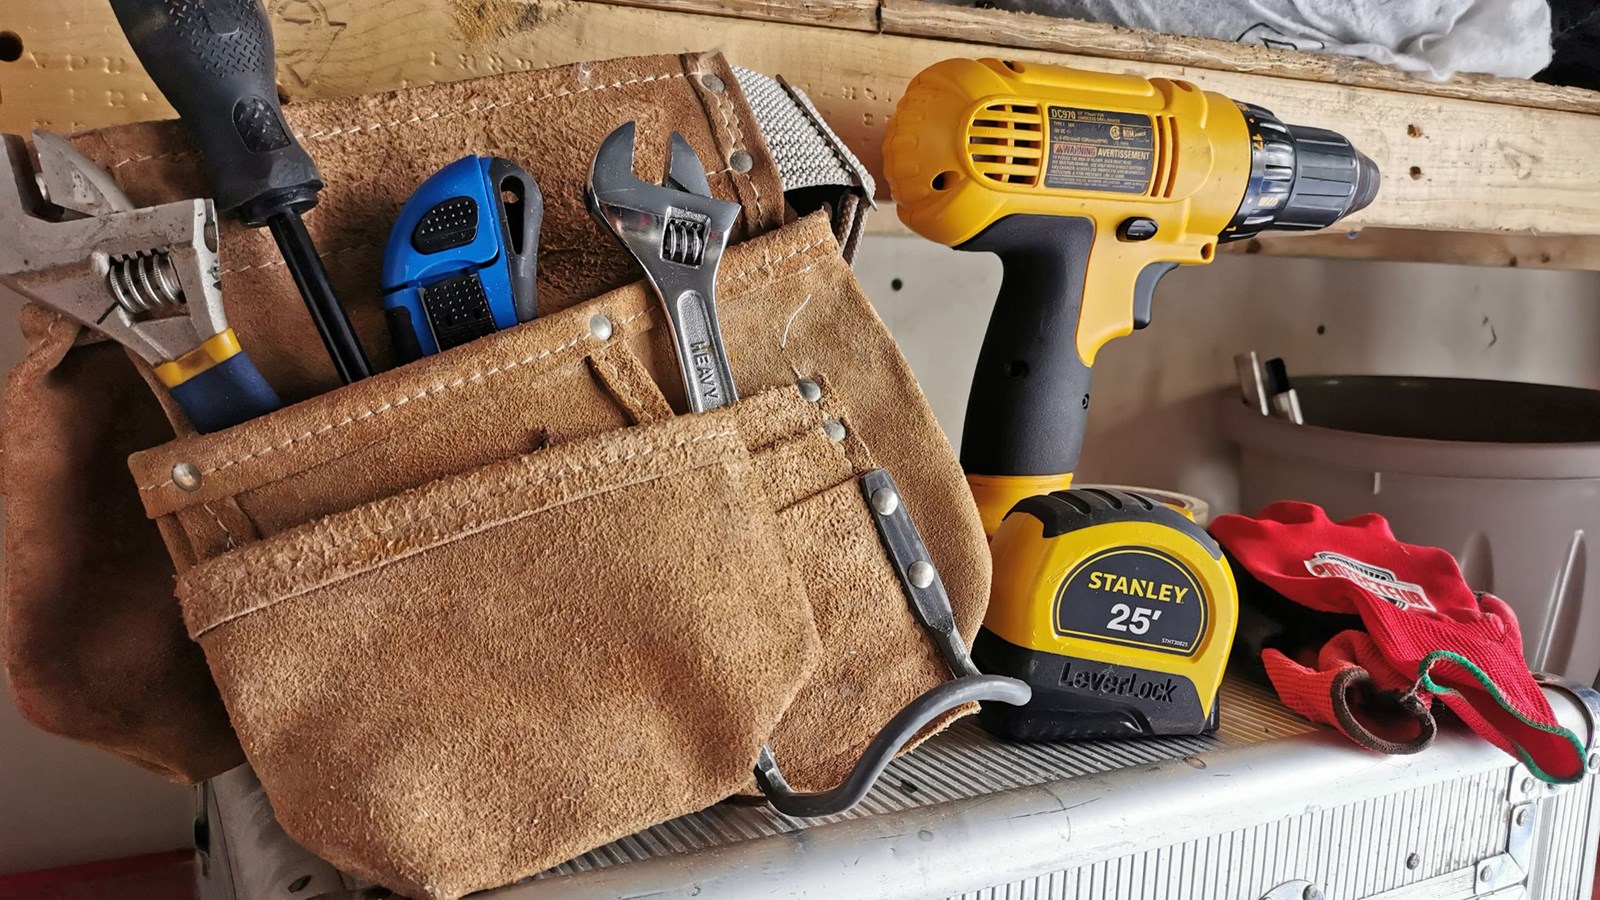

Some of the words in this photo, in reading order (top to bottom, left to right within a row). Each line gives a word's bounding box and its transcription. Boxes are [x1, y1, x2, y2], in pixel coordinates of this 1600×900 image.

[1051, 108, 1076, 119] DC970
[1063, 145, 1096, 156] WARNING
[1097, 148, 1150, 160] AVERTISSEMENT
[690, 340, 719, 399] HEAVY
[1088, 571, 1189, 604] STANLEY
[1106, 603, 1162, 635] 25'
[1058, 662, 1178, 703] LeverLock
